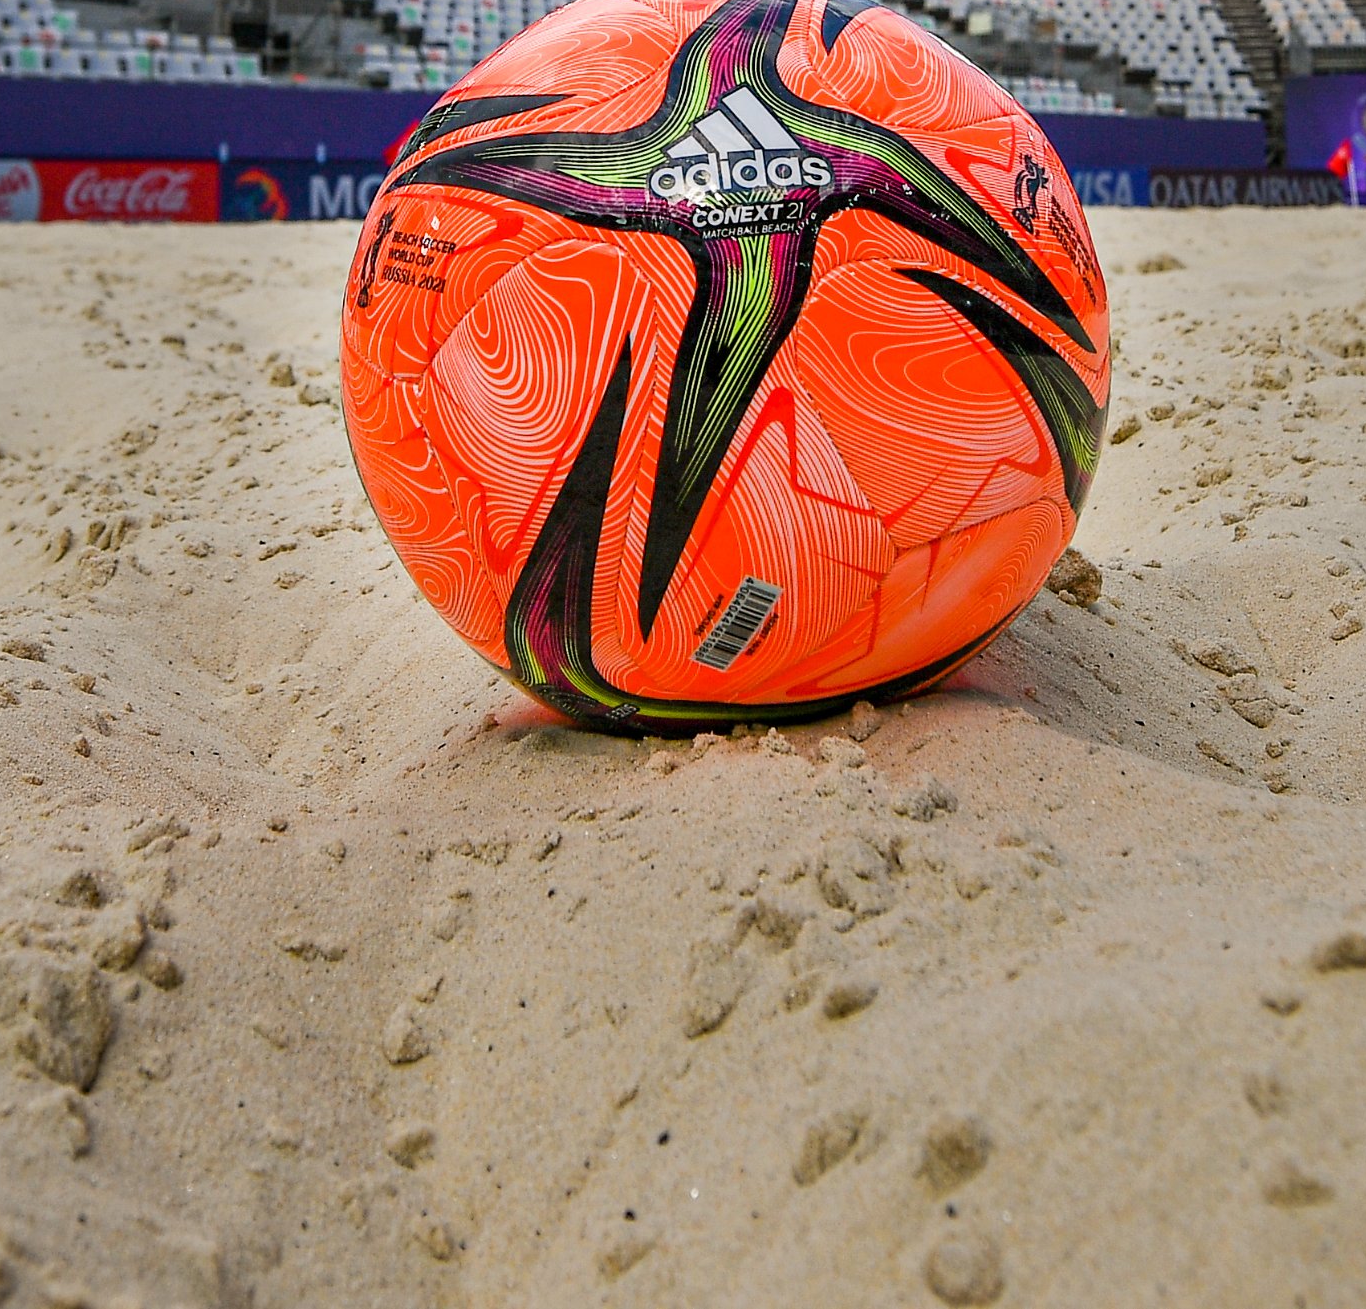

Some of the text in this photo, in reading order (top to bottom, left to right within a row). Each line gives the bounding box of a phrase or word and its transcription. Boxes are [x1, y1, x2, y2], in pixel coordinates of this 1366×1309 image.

[650, 149, 832, 197] adidas
[64, 167, 193, 214] Coca-Cola
[1149, 174, 1235, 206] QATAR
[692, 202, 804, 228] CONEXT 21
[391, 231, 456, 254] BEACH SOCCER
[702, 222, 795, 240] MATCH BALL BEACH
[387, 248, 434, 268] WORLD CUP
[381, 265, 446, 293] RUSSIA 2021
